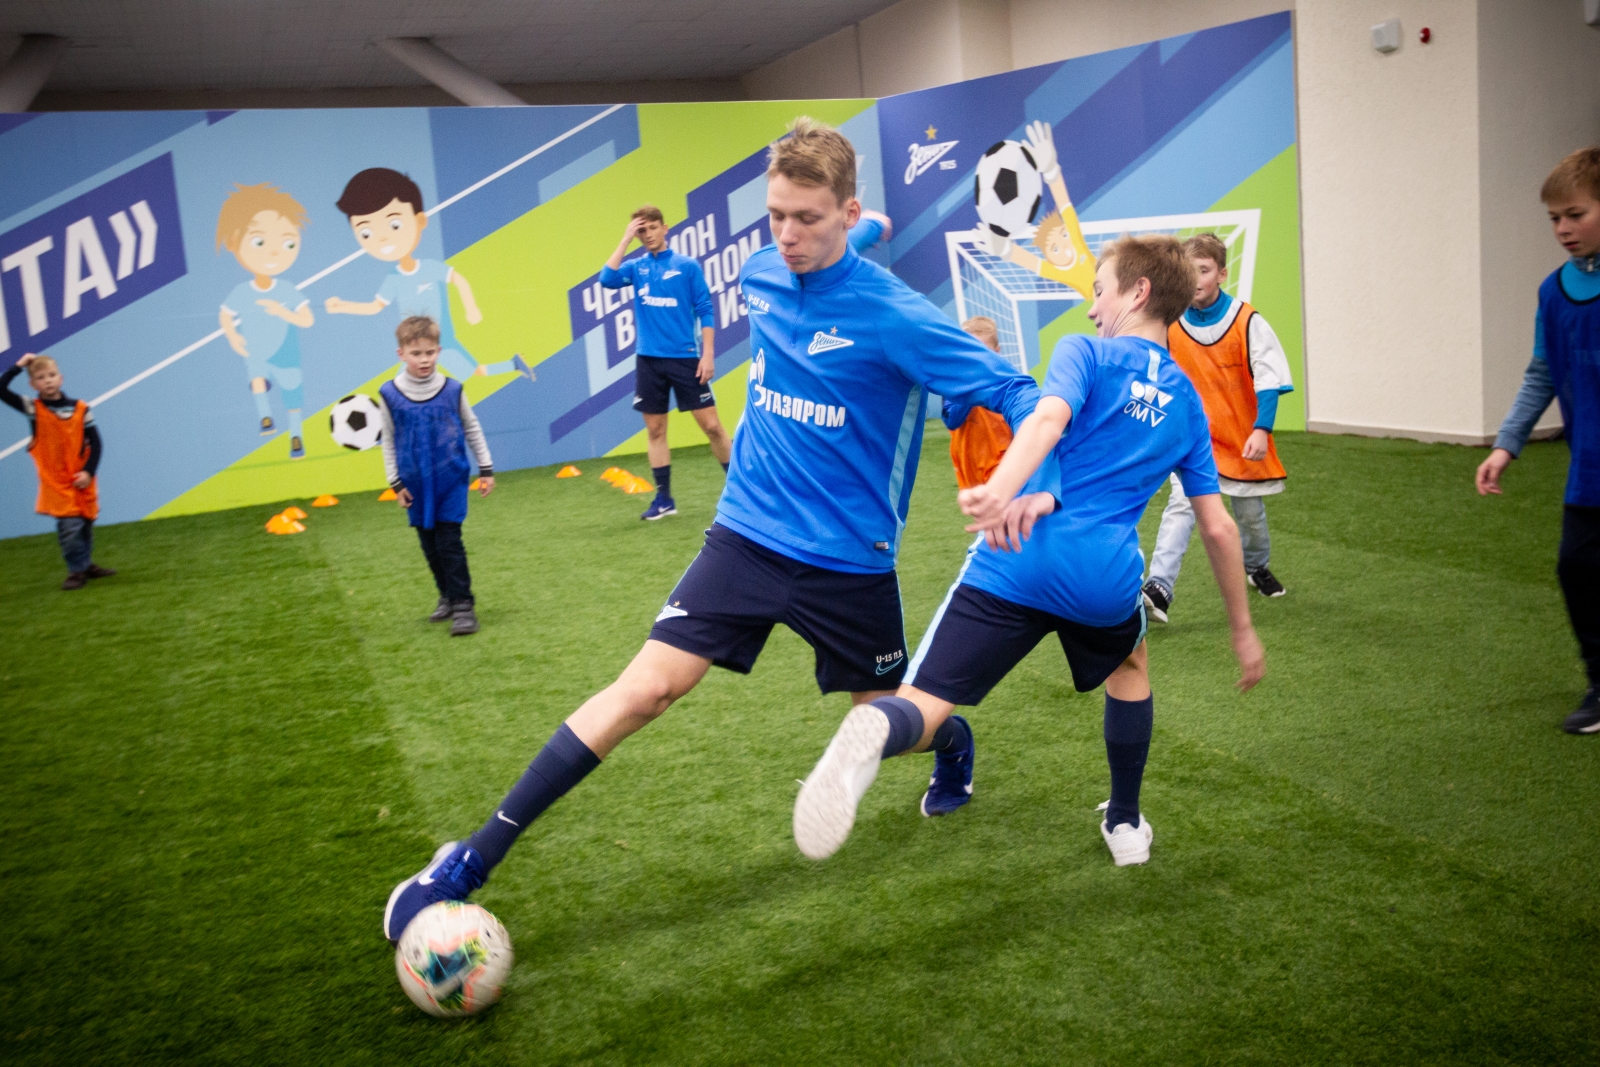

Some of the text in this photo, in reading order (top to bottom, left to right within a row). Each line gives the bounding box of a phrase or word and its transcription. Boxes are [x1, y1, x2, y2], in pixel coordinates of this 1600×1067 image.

[0, 200, 158, 353] ТА»
[766, 389, 846, 427] ГАЗПРОМ
[1124, 400, 1165, 428] OMV
[876, 654, 892, 663] U-15
